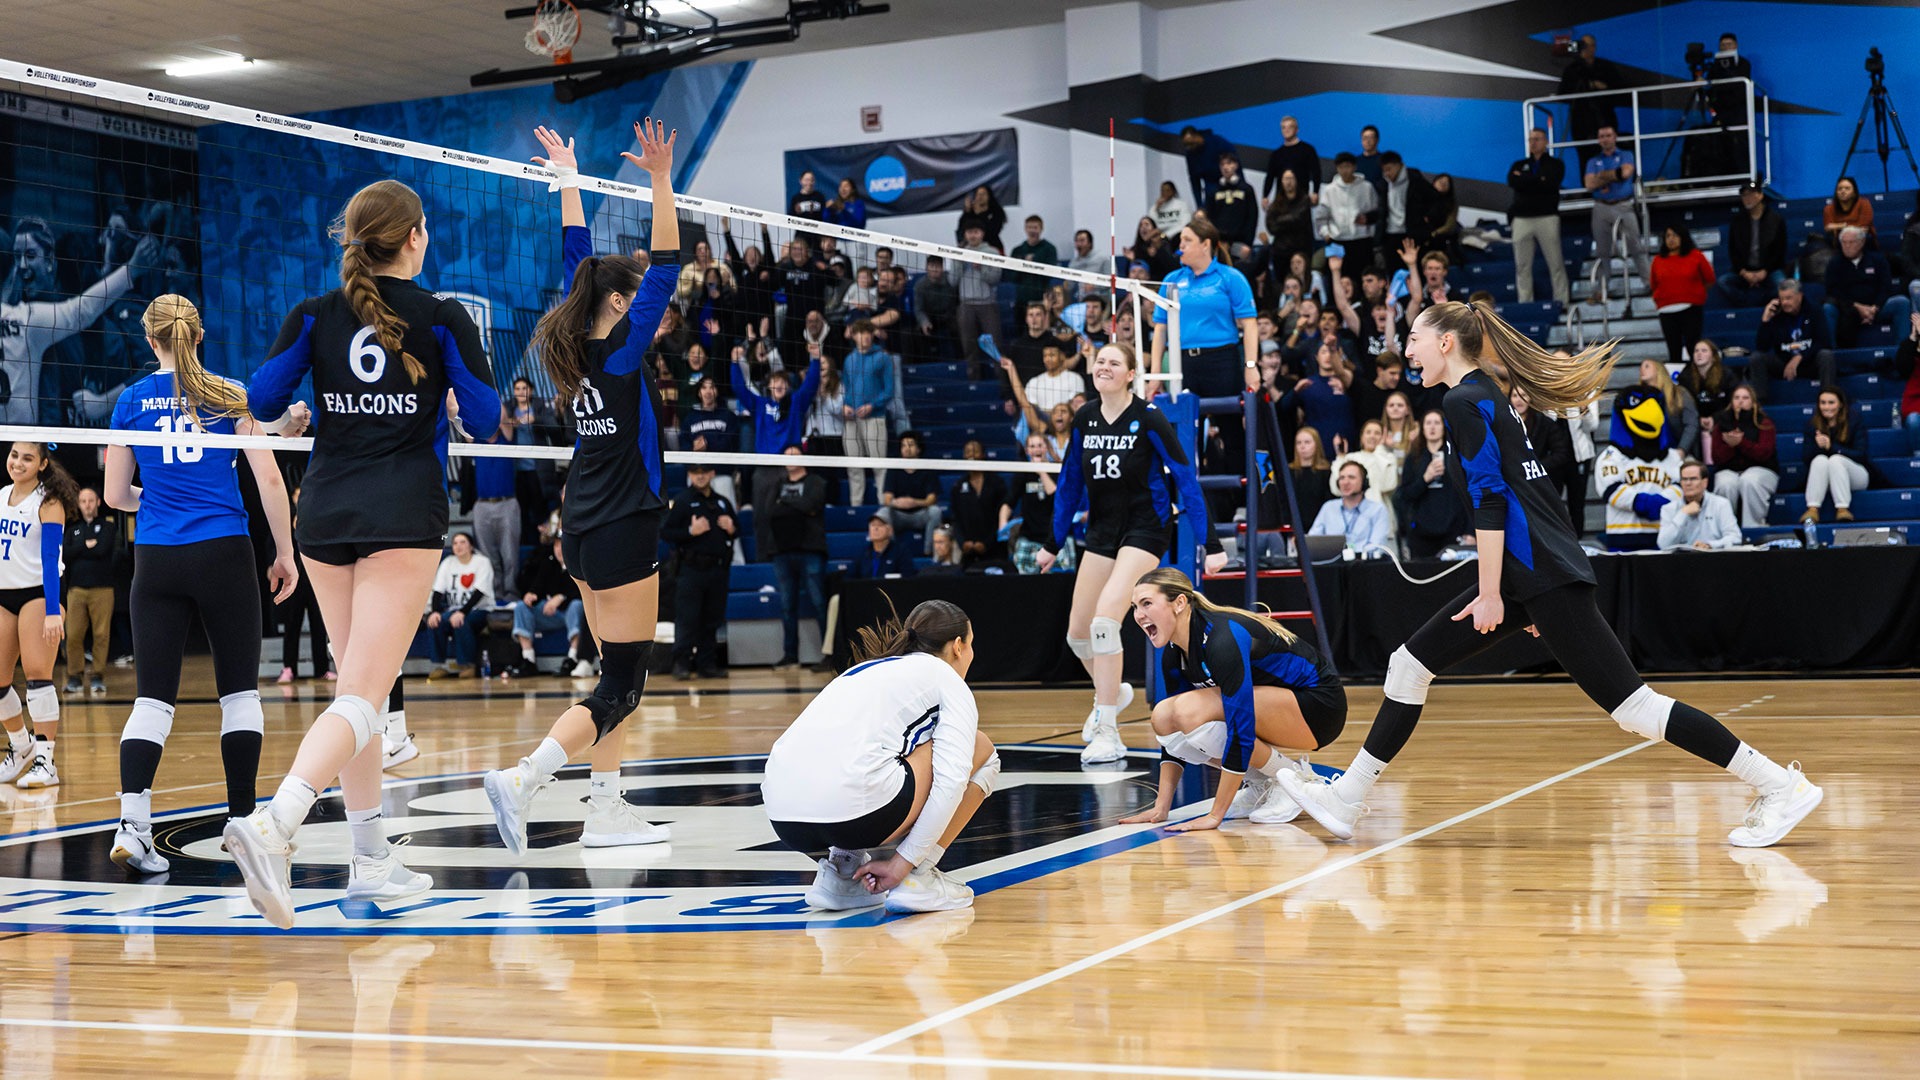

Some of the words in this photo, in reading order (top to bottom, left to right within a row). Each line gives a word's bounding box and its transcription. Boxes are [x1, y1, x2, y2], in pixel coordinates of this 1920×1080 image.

[33, 70, 61, 83] VOLLEYBALL
[61, 75, 97, 89] CHAMPIONSHIP
[153, 94, 178, 106] VOLLEYBALL
[178, 99, 211, 111] CHAMPIONSHIP
[102, 116, 193, 146] VOLLEYBALL
[261, 115, 283, 126] VOLLEYBALL
[283, 119, 313, 131] CHAMPIONSHIP
[359, 134, 379, 145] VOLLEYBALL
[379, 138, 406, 149] CHAMPIONSHIP
[447, 151, 466, 162] VOLLEYBALL
[466, 155, 490, 165] CHAMPIONSHIP
[348, 324, 387, 383] 6
[323, 393, 418, 415] FALCONS
[576, 417, 617, 436] LCONS
[1082, 434, 1138, 450] BENTLEY
[1089, 453, 1122, 480] 18
[0, 518, 32, 538] RCY
[1, 538, 12, 561] 7
[451, 573, 460, 590] I
